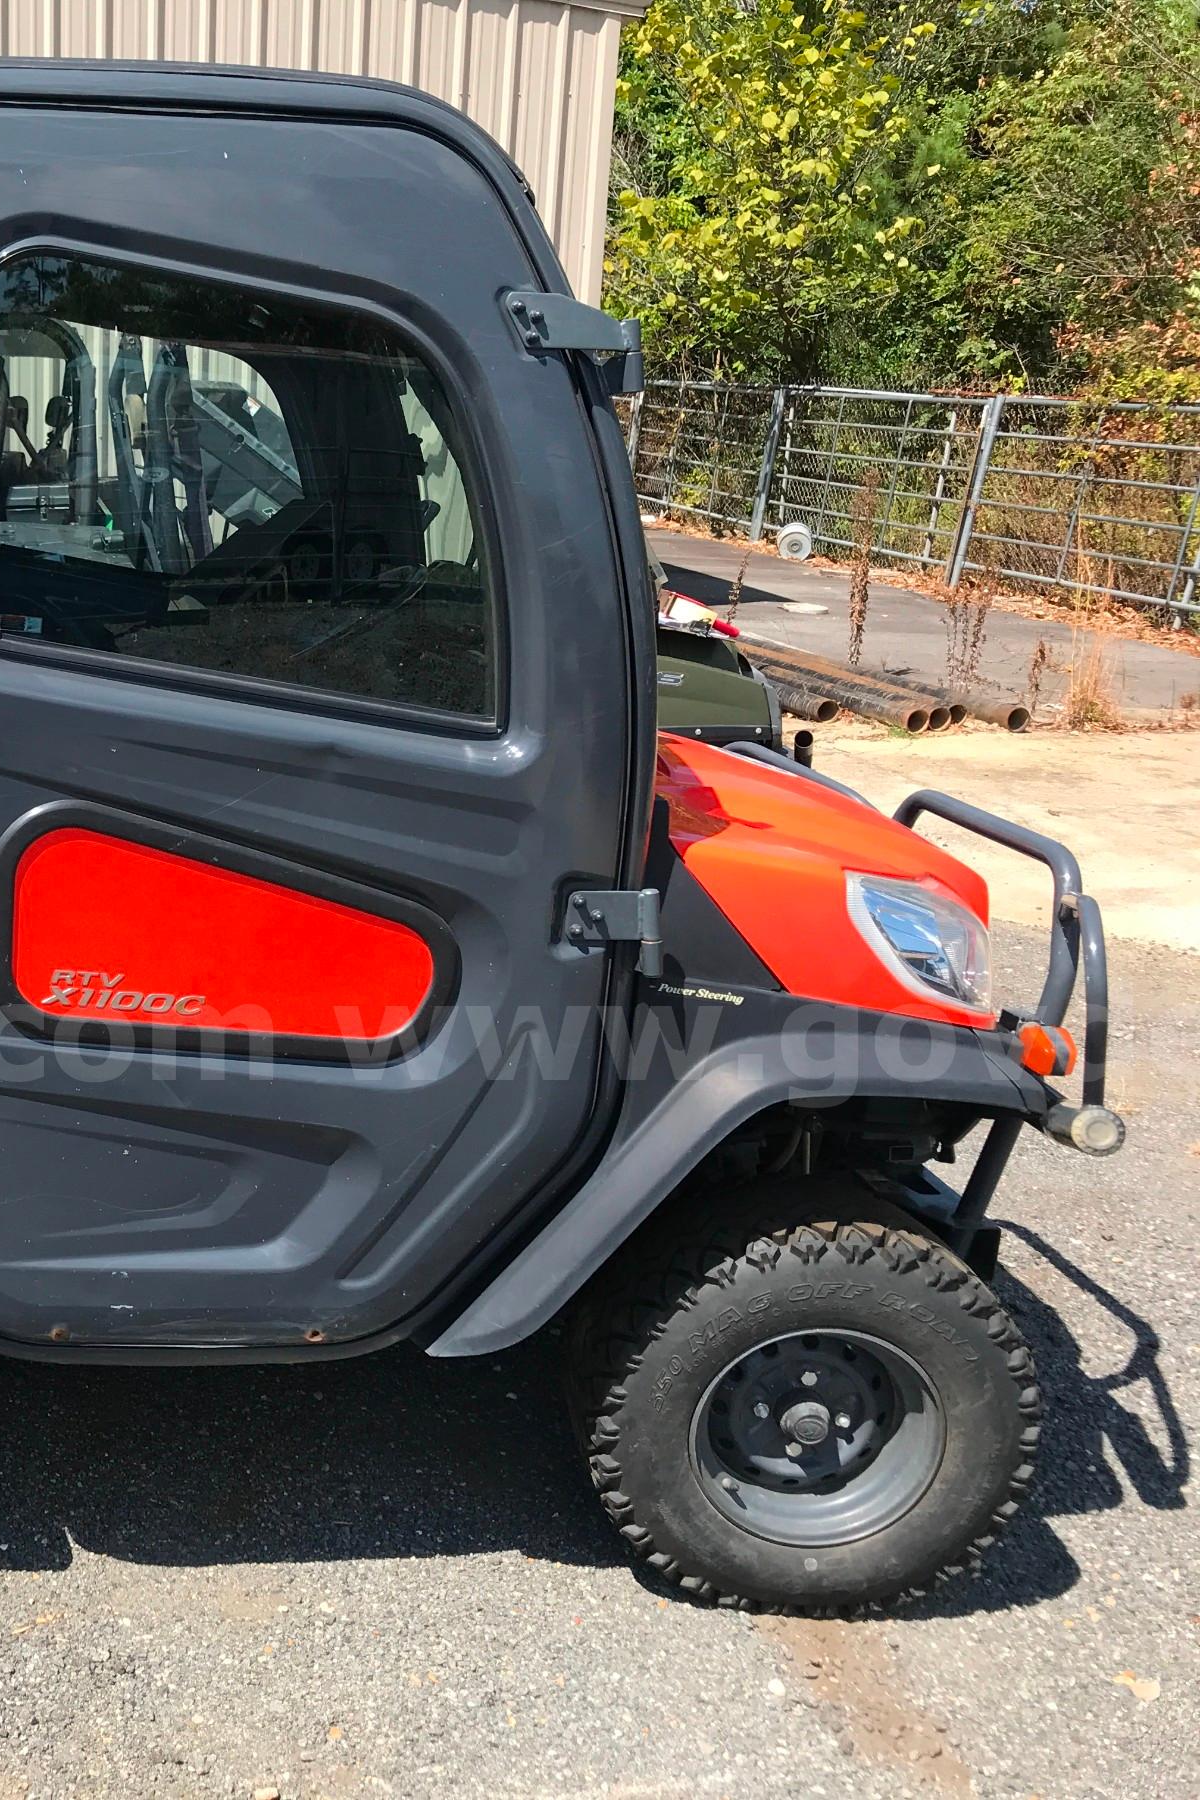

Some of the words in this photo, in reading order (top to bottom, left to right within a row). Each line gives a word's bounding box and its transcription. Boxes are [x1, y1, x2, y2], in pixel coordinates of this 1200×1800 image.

[51, 969, 125, 988] RTV
[41, 985, 206, 1017] X1100C
[658, 983, 696, 996] Power
[696, 988, 745, 1006] Steering
[689, 1290, 773, 1353] MAG
[786, 1282, 874, 1302] OFF
